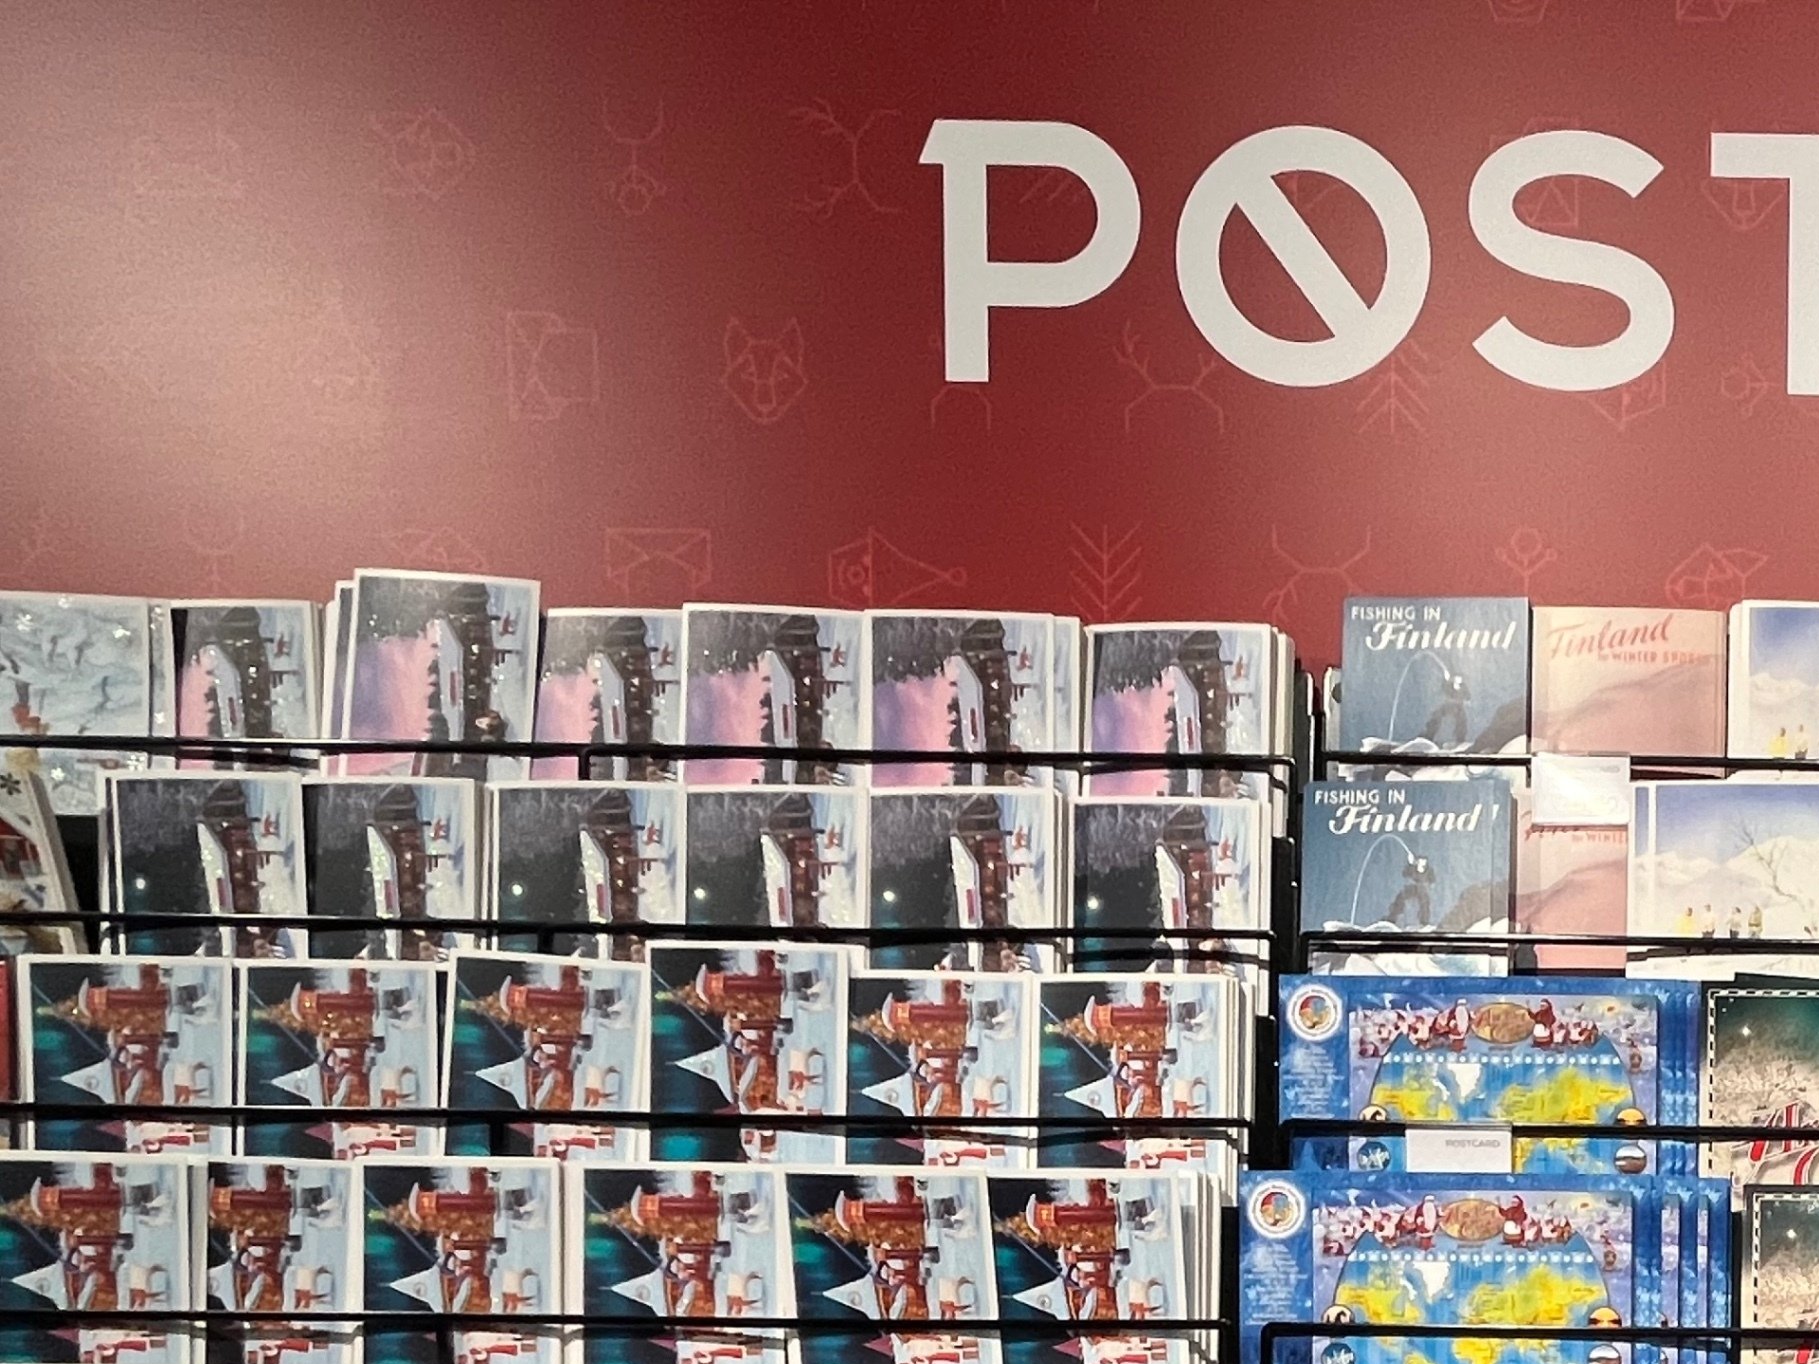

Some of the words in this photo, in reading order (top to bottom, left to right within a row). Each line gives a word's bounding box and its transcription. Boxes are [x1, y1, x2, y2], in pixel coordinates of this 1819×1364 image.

[1350, 605, 1417, 621] FISHING
[1423, 606, 1442, 622] IN
[1365, 620, 1518, 652] Finland
[1547, 612, 1675, 661] Finland
[1314, 789, 1380, 805] FISHING
[1387, 788, 1406, 805] IN
[1327, 803, 1483, 835] Finland
